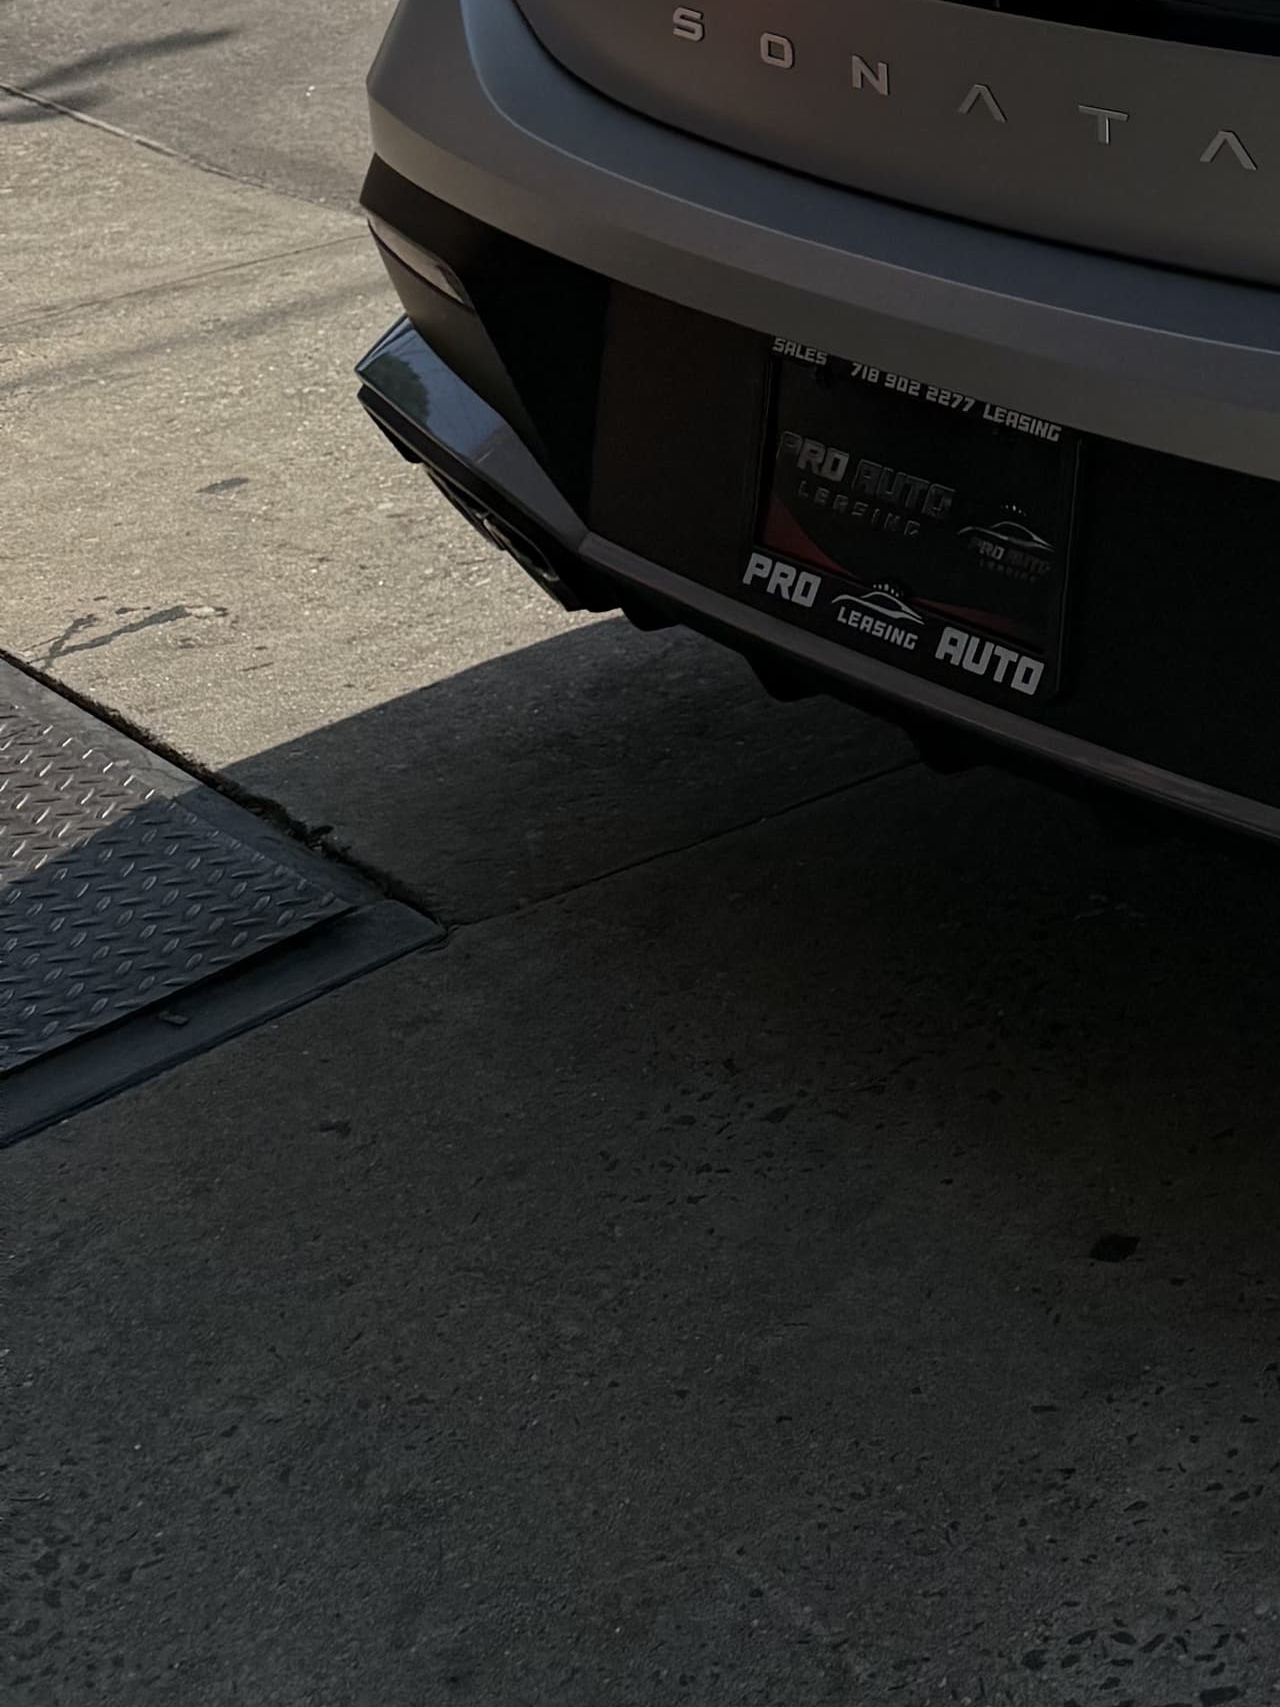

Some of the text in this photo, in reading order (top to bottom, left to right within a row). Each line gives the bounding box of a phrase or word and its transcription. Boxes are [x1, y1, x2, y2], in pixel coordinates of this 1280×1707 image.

[672, 5, 1257, 172] SONATA
[772, 338, 1062, 443] SALES 718 902 2277 LEASING
[777, 429, 957, 521] PRO AUTO
[797, 480, 922, 538] LEASING
[742, 551, 1046, 697] PRO LEASING AUTO
